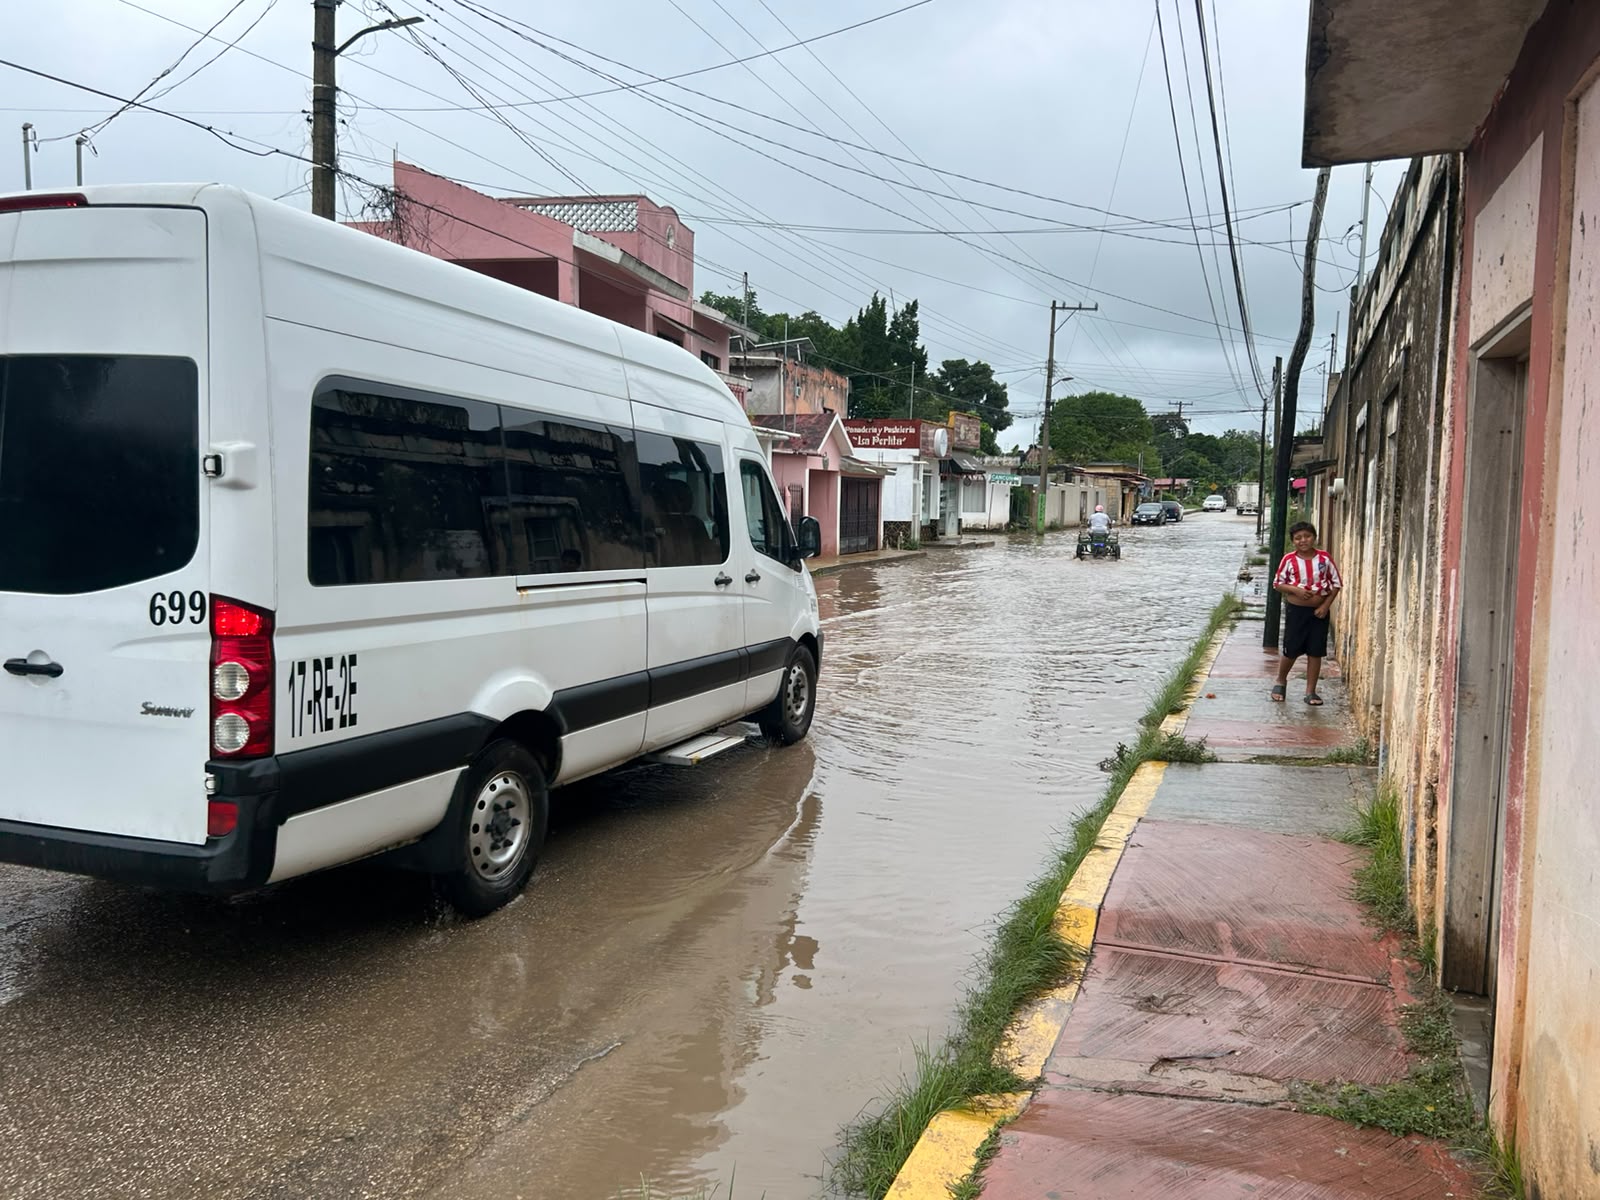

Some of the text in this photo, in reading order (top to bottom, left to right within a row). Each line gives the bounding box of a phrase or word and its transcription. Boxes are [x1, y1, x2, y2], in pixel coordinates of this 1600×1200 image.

[877, 427, 883, 437] y
[149, 590, 207, 626] 699
[288, 654, 358, 738] 17-RE-2E
